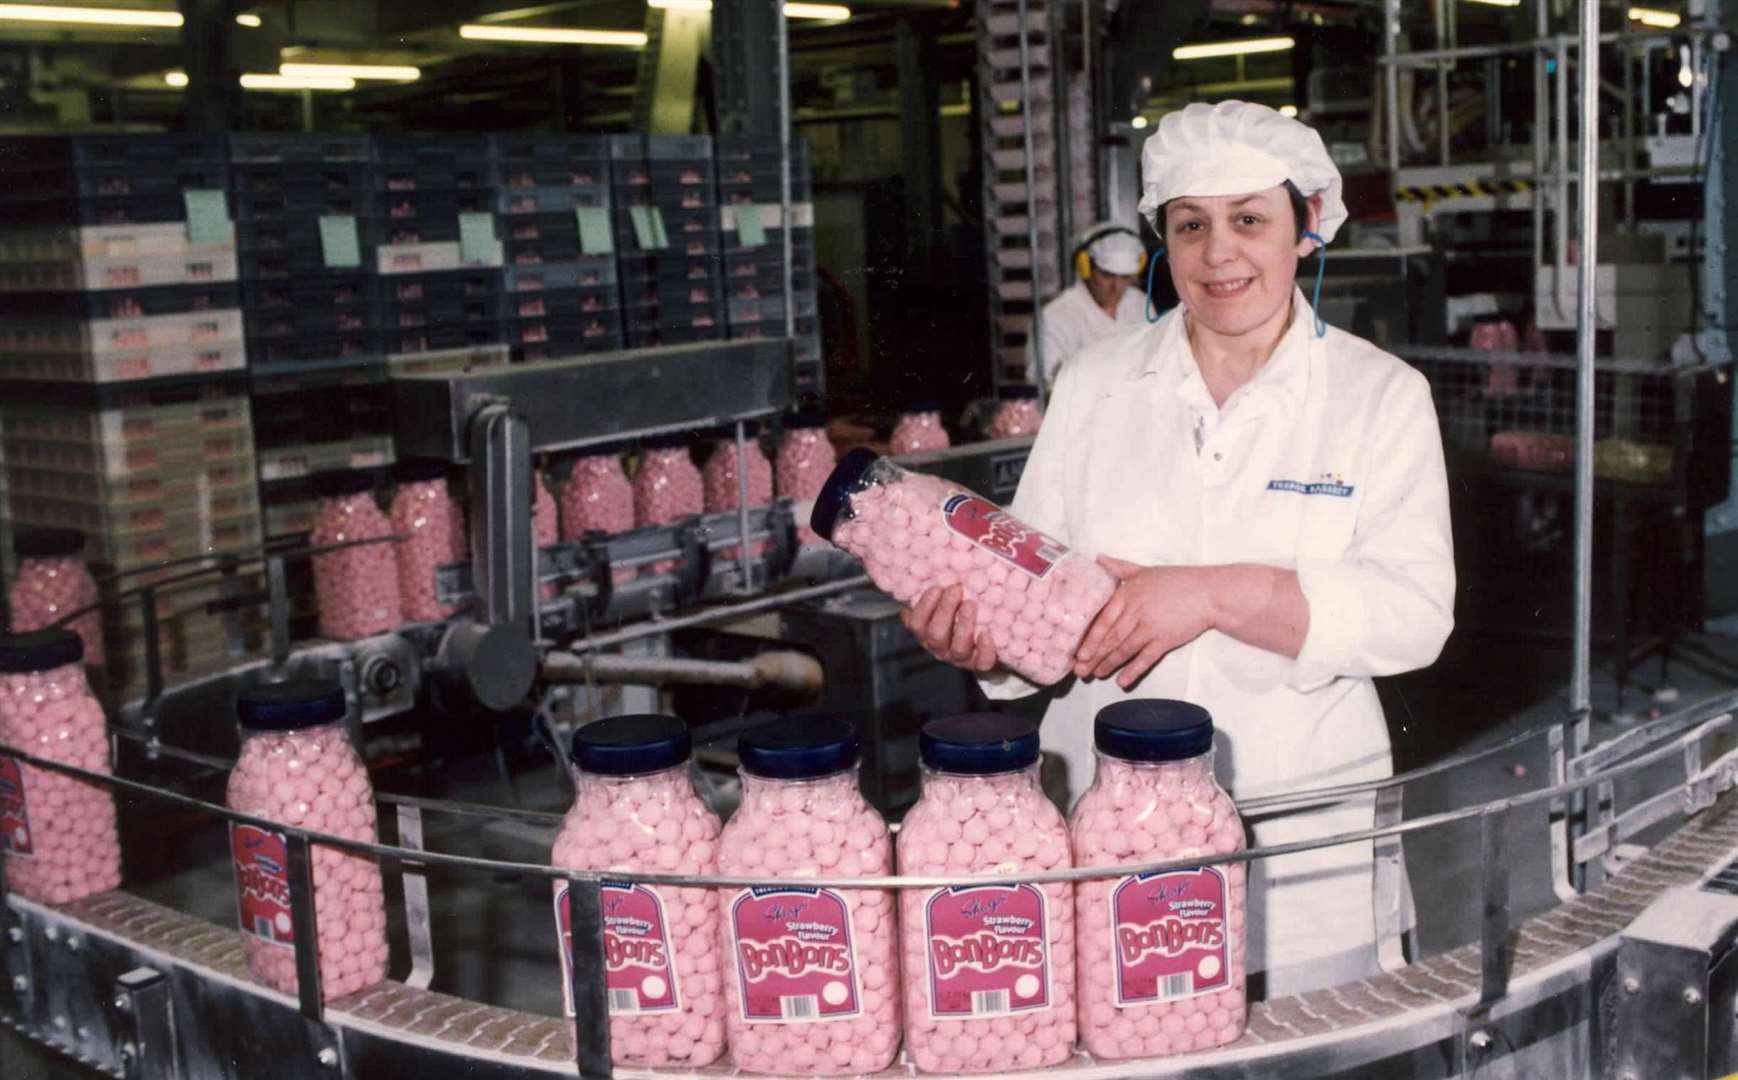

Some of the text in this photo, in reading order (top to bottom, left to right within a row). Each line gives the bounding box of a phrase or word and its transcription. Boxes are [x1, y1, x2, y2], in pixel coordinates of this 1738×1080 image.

[983, 914, 1034, 929] Strawberry
[1168, 898, 1216, 911] Strawberry
[785, 921, 839, 936] Strawberry
[1118, 918, 1224, 963] BonBons
[605, 932, 667, 967] Bons
[739, 937, 850, 979] BonBons
[931, 932, 1044, 975] BonBons
